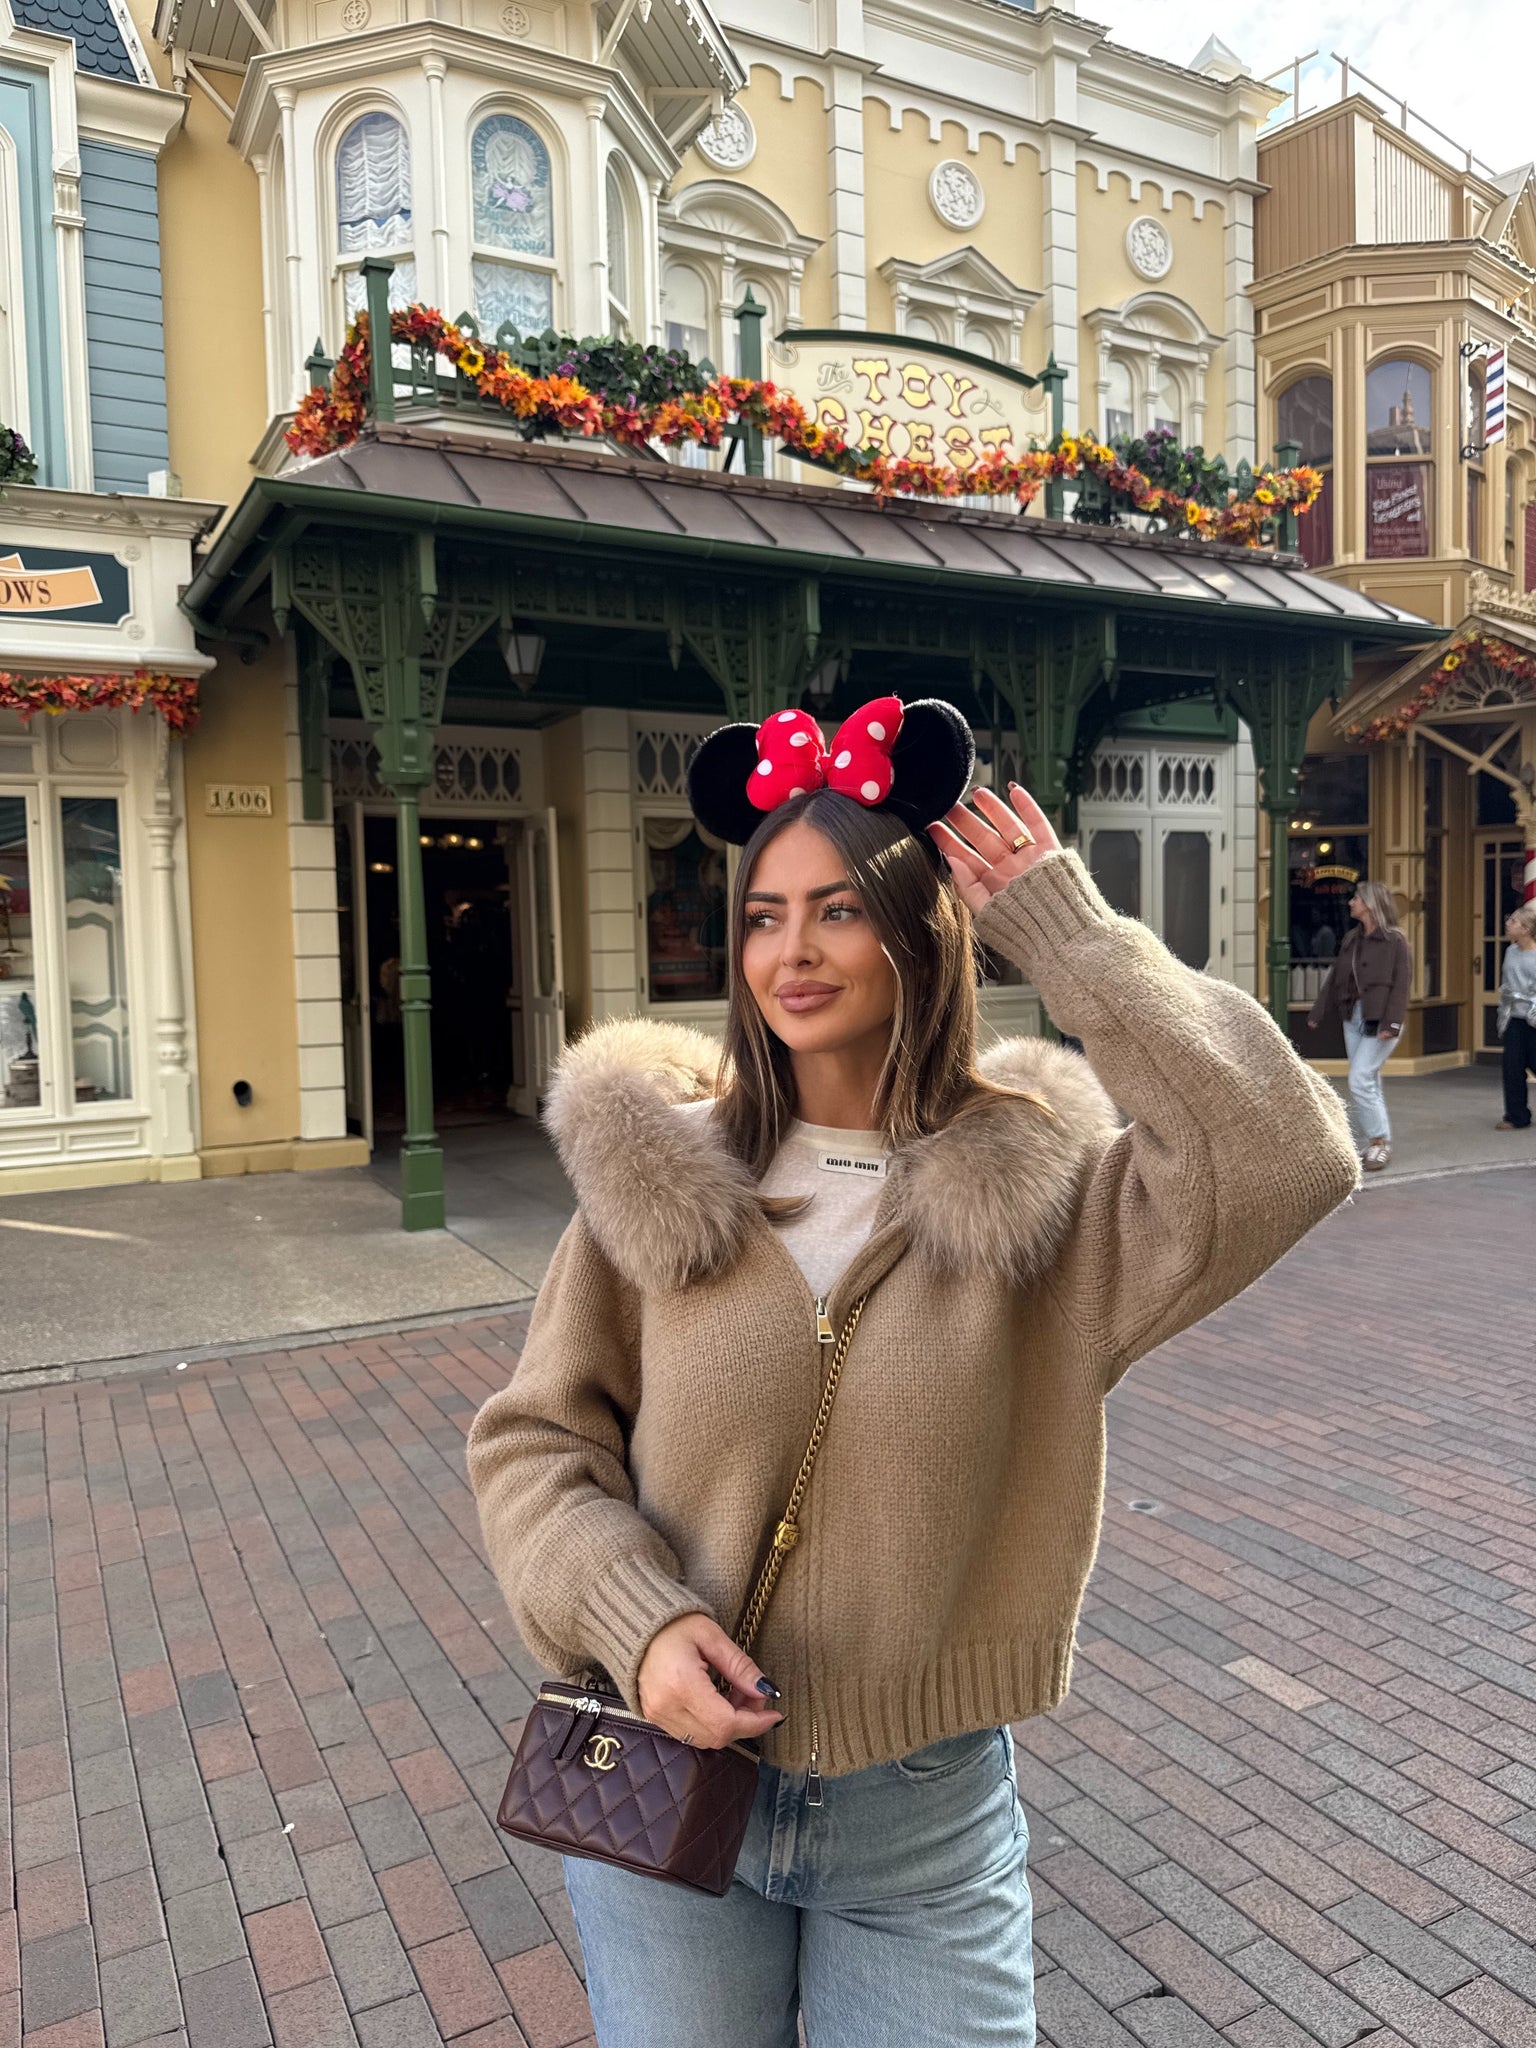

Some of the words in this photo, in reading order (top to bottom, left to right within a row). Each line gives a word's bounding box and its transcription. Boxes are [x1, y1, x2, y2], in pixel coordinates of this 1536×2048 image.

[817, 361, 853, 393] The
[852, 357, 978, 417] TOY
[814, 396, 1013, 469] CHEST
[211, 791, 267, 809] 1406
